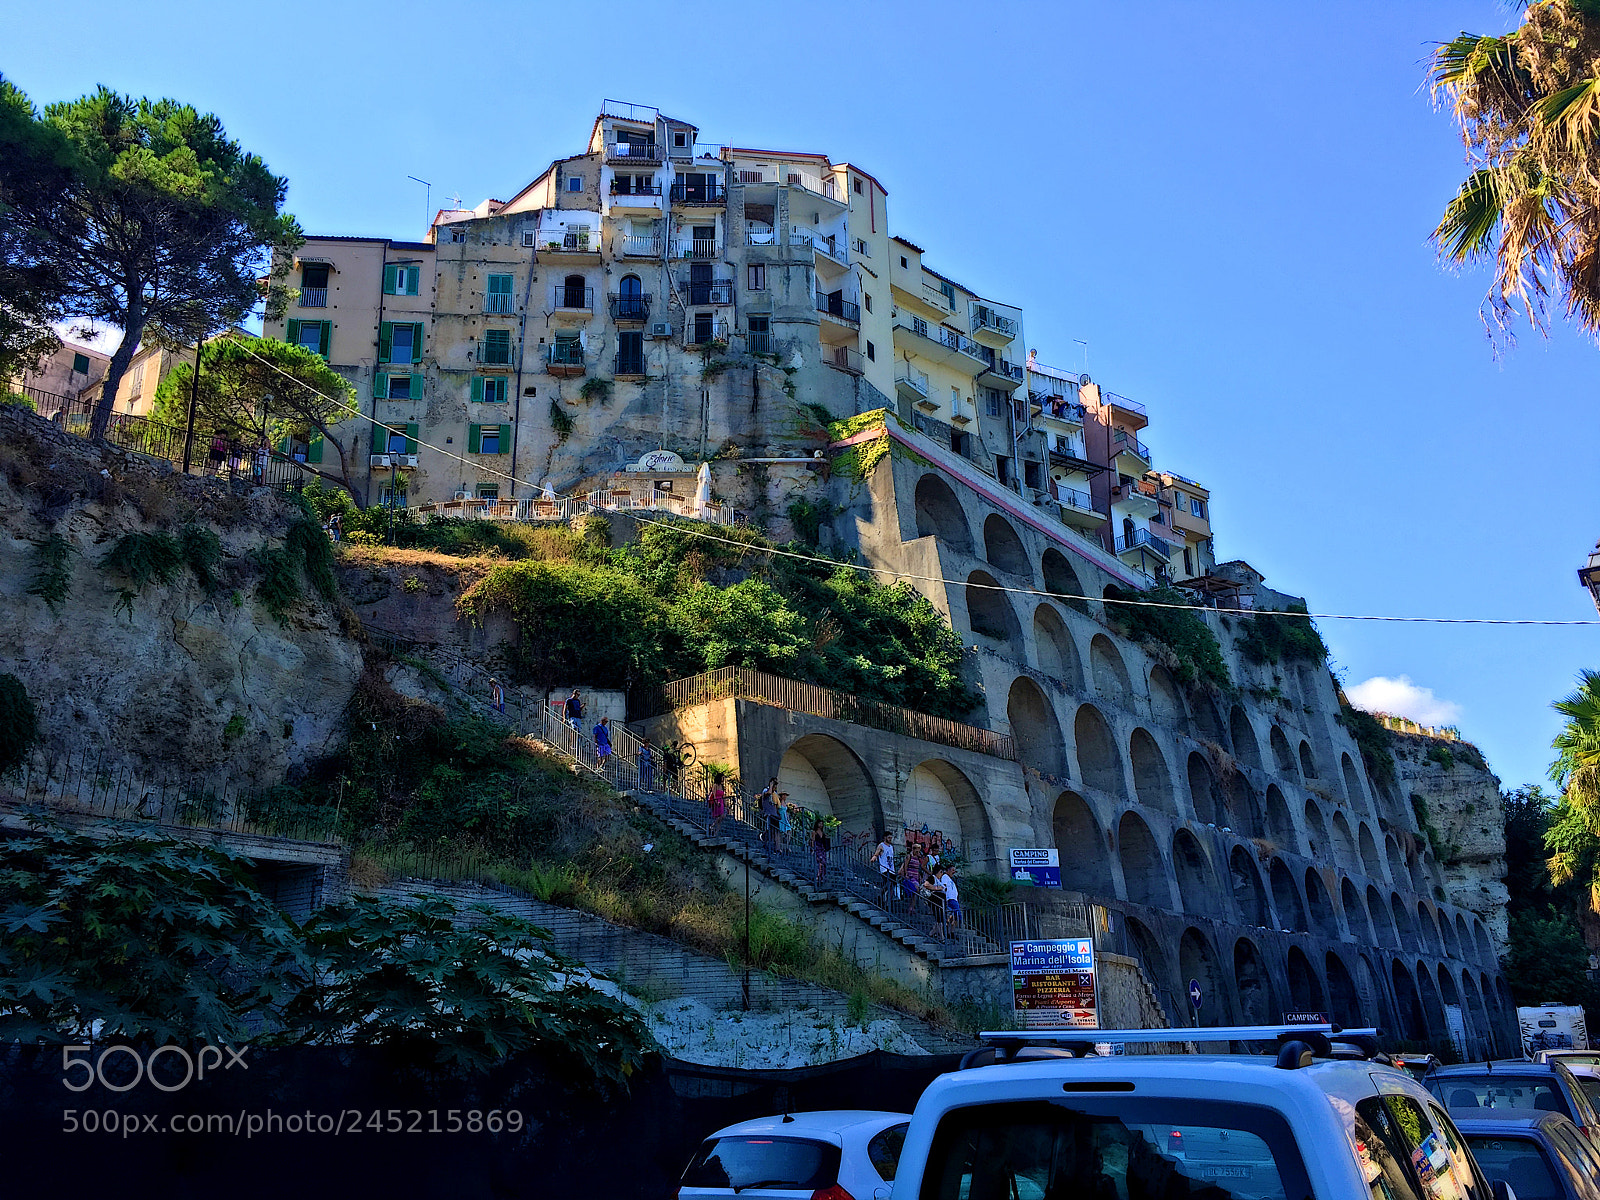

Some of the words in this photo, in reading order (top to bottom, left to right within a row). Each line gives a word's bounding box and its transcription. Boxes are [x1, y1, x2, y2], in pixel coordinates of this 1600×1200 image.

[1014, 850, 1048, 858] CAMPING
[1027, 942, 1075, 954] Campeggio
[1013, 956, 1046, 966] Marina
[1048, 954, 1091, 965] dell'Isola
[1287, 1013, 1319, 1021] CAMPING
